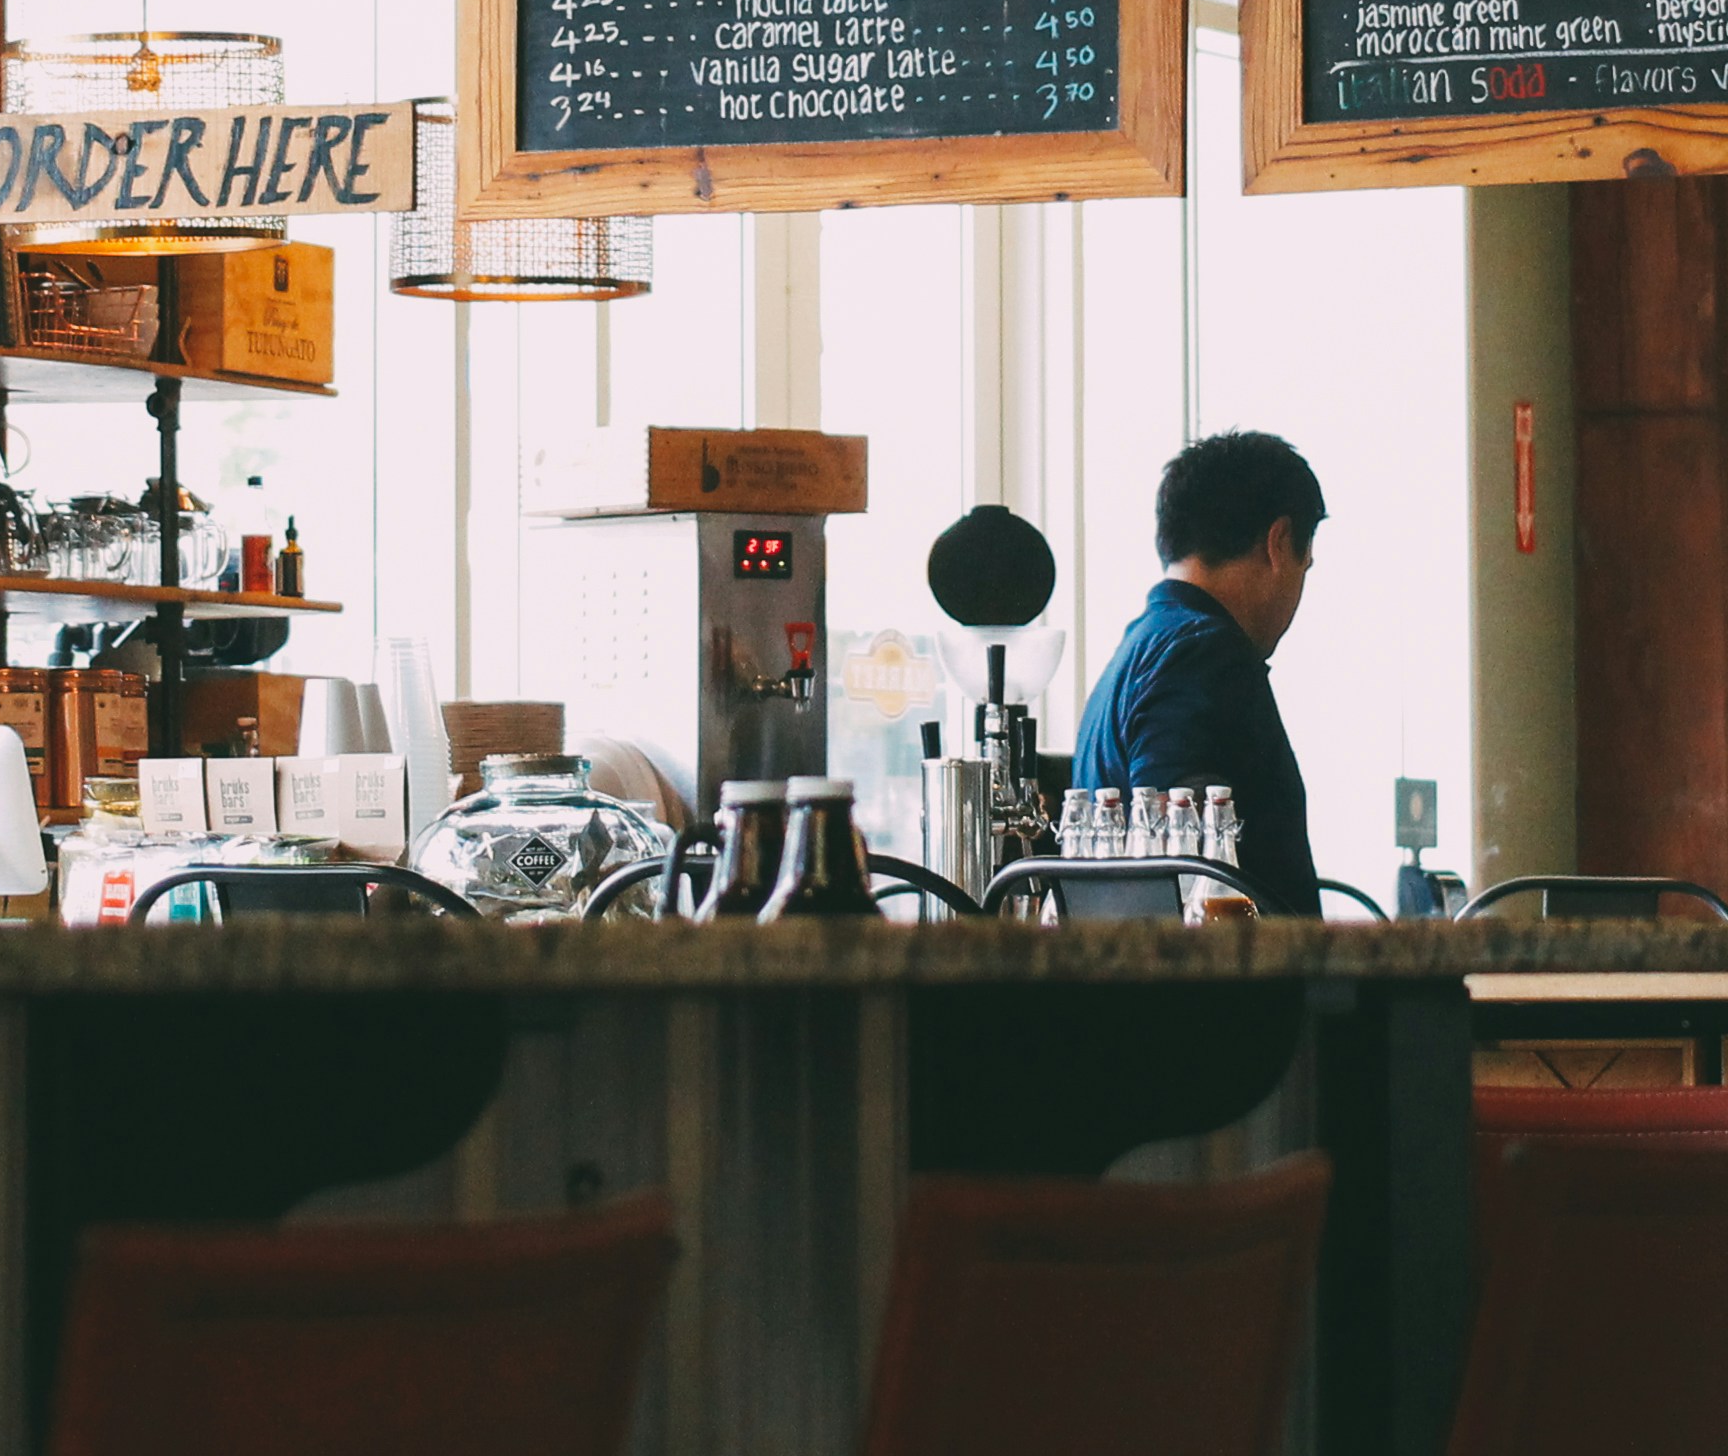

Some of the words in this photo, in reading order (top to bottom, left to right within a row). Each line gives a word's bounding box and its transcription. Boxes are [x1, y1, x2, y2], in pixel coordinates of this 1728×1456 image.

[714, 20, 823, 50] caramel
[835, 16, 905, 46] latte
[1356, 1, 1444, 33] jasmine
[1356, 24, 1480, 57] moroccan
[1489, 23, 1546, 52] mint
[1556, 15, 1621, 49] green
[690, 55, 780, 86] vanilla
[792, 51, 875, 84] sugar
[888, 46, 956, 79] latte
[1471, 63, 1546, 103] soda
[1595, 64, 1697, 94] flavors
[720, 89, 763, 121] hot
[770, 83, 905, 121] chocolate
[215, 112, 392, 208] HERE
[516, 855, 555, 866] COFFEE
